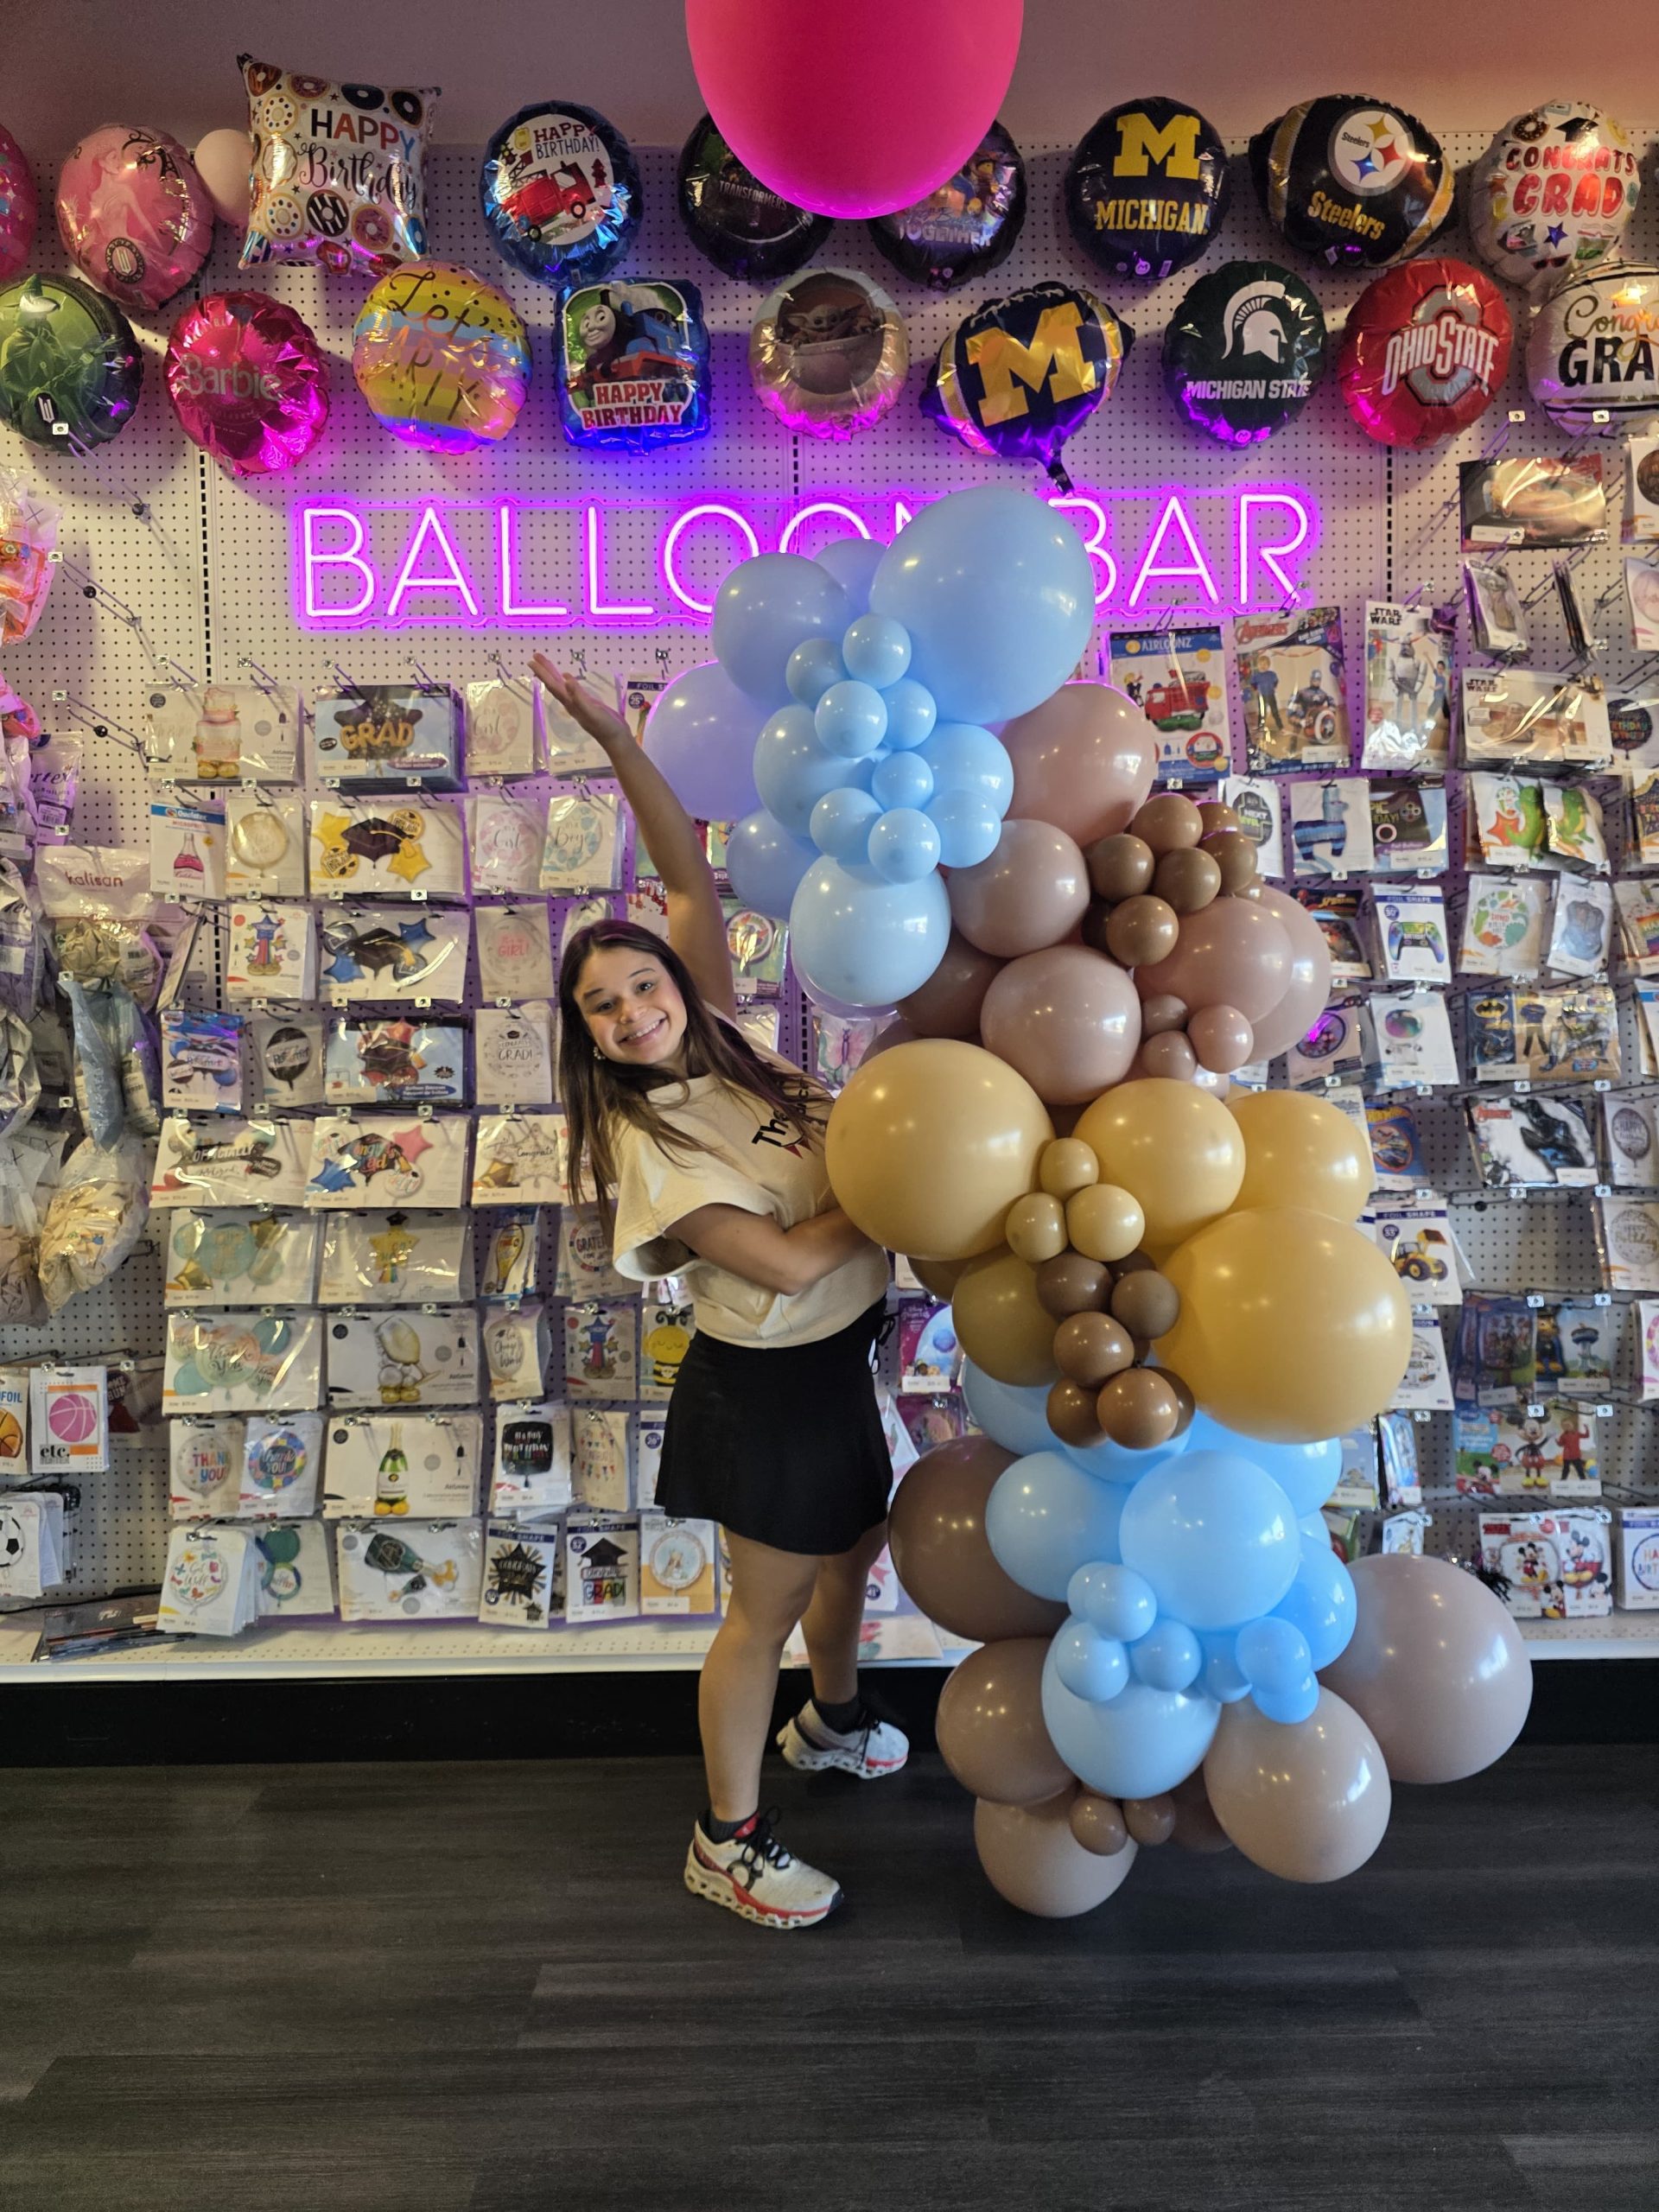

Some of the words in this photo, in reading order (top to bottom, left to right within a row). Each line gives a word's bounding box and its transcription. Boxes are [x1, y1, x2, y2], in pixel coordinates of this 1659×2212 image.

[311, 109, 415, 162] HAPPY
[534, 122, 597, 143] HAPPY
[1114, 112, 1201, 180] M
[1342, 132, 1370, 149] Steelers
[536, 137, 600, 159] BIRTHDAY!
[1506, 147, 1635, 175] CONGRATS
[297, 142, 416, 211] Birthday
[719, 180, 787, 210] TRANSFORMERS
[1512, 174, 1625, 218] GRAD
[1095, 200, 1208, 235] MICHIGAN
[1307, 190, 1385, 240] Steelers
[1564, 295, 1659, 362] Congr
[965, 302, 1100, 427] M
[1559, 334, 1659, 387] GRA
[169, 353, 283, 402] Barbie
[1186, 380, 1267, 400] MICHIGAN
[1269, 379, 1313, 398] STATE
[595, 381, 664, 404] HAPPY
[582, 404, 682, 429] BIRTHDAY
[304, 502, 912, 619] BALLO
[1047, 496, 1306, 606] BAR
[1370, 607, 1402, 618] STAR
[1370, 616, 1402, 626] WARS
[340, 719, 415, 752] GRAD
[1370, 802, 1390, 814] PIC
[65, 871, 124, 887] kalisan
[193, 1144, 255, 1162] OFCIALLY
[0, 1391, 22, 1403] FOIL
[40, 1445, 70, 1458] etc.
